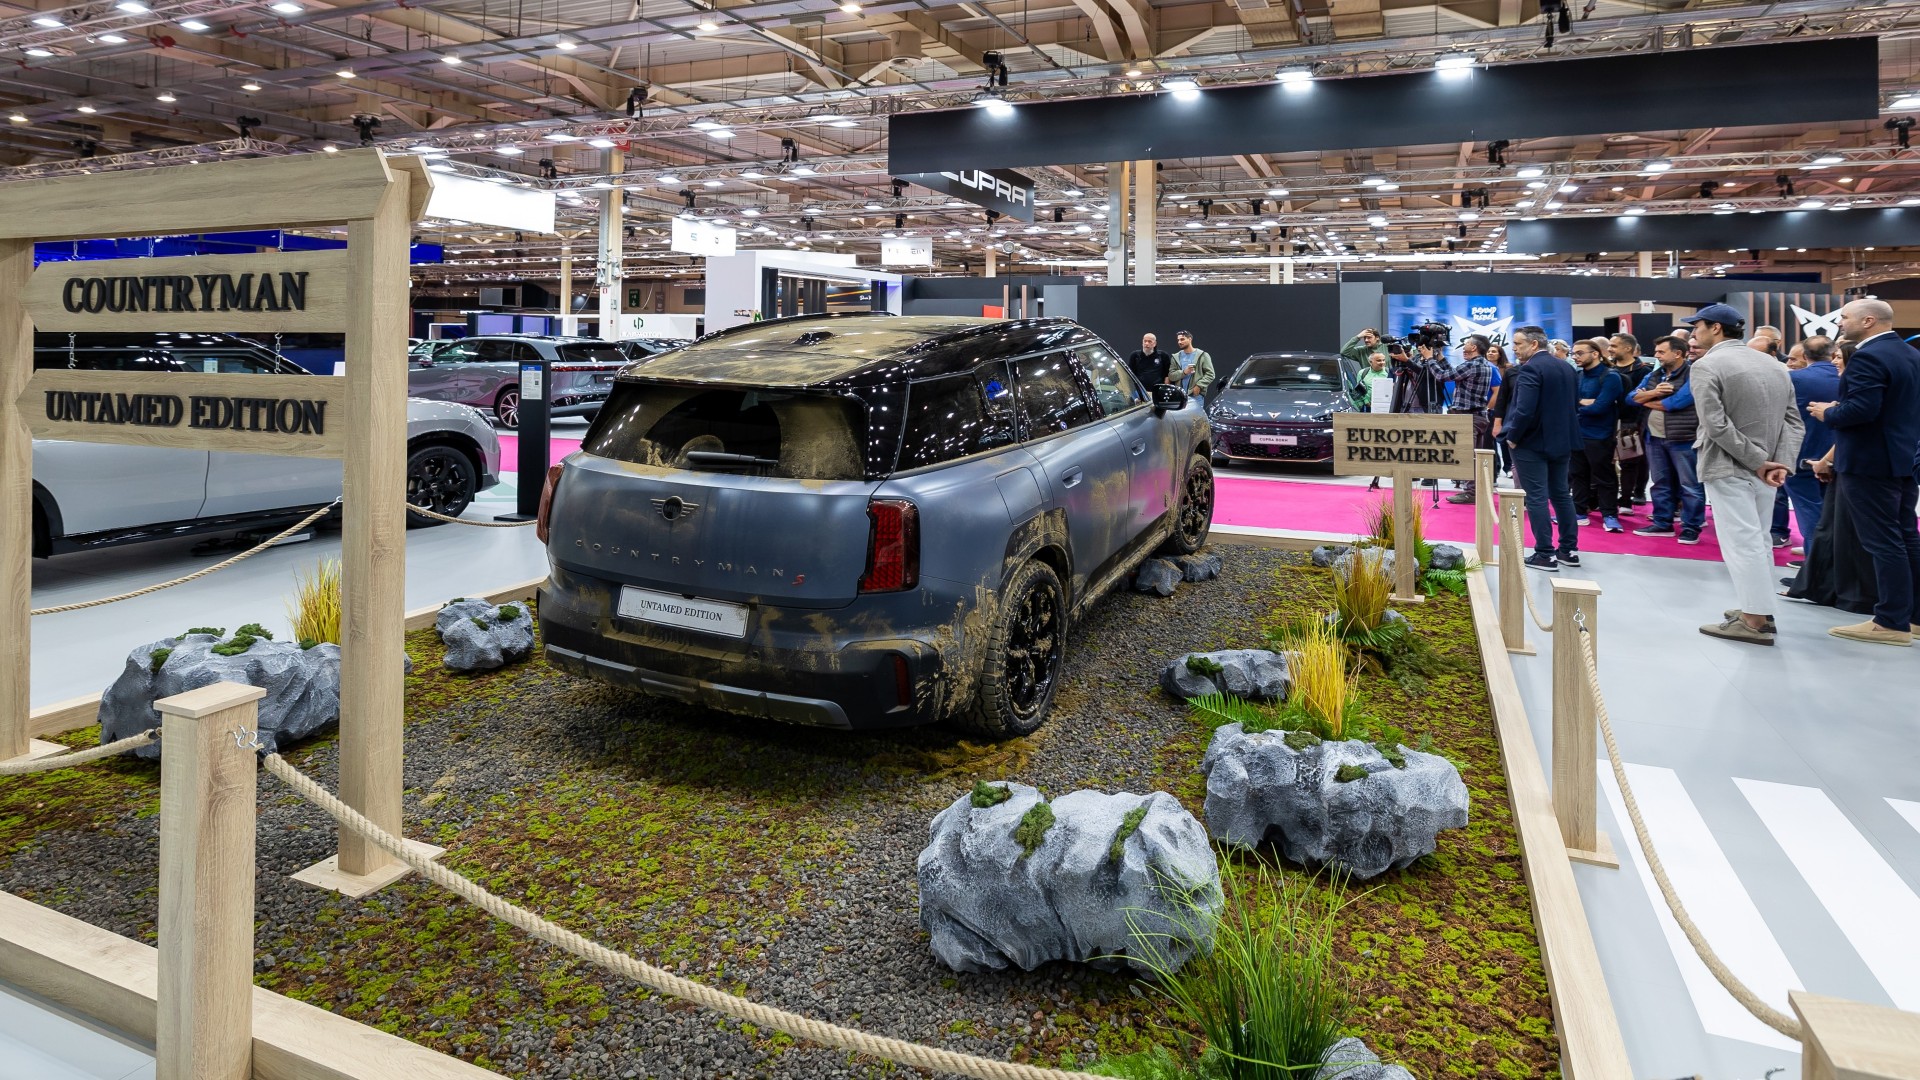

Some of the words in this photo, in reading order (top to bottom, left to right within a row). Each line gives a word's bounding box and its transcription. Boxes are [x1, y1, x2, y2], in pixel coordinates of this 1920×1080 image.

[63, 271, 309, 313] COUNTRYMAN
[45, 391, 184, 426] UNTAMED
[188, 396, 327, 435] EDITION
[1346, 428, 1457, 445] EUROPEAN
[1347, 446, 1460, 465] PREMIERE.
[576, 539, 784, 577] COUNTRYMAN
[792, 574, 805, 586] S
[640, 600, 683, 615] UNTAMED
[684, 607, 723, 622] EDITION
